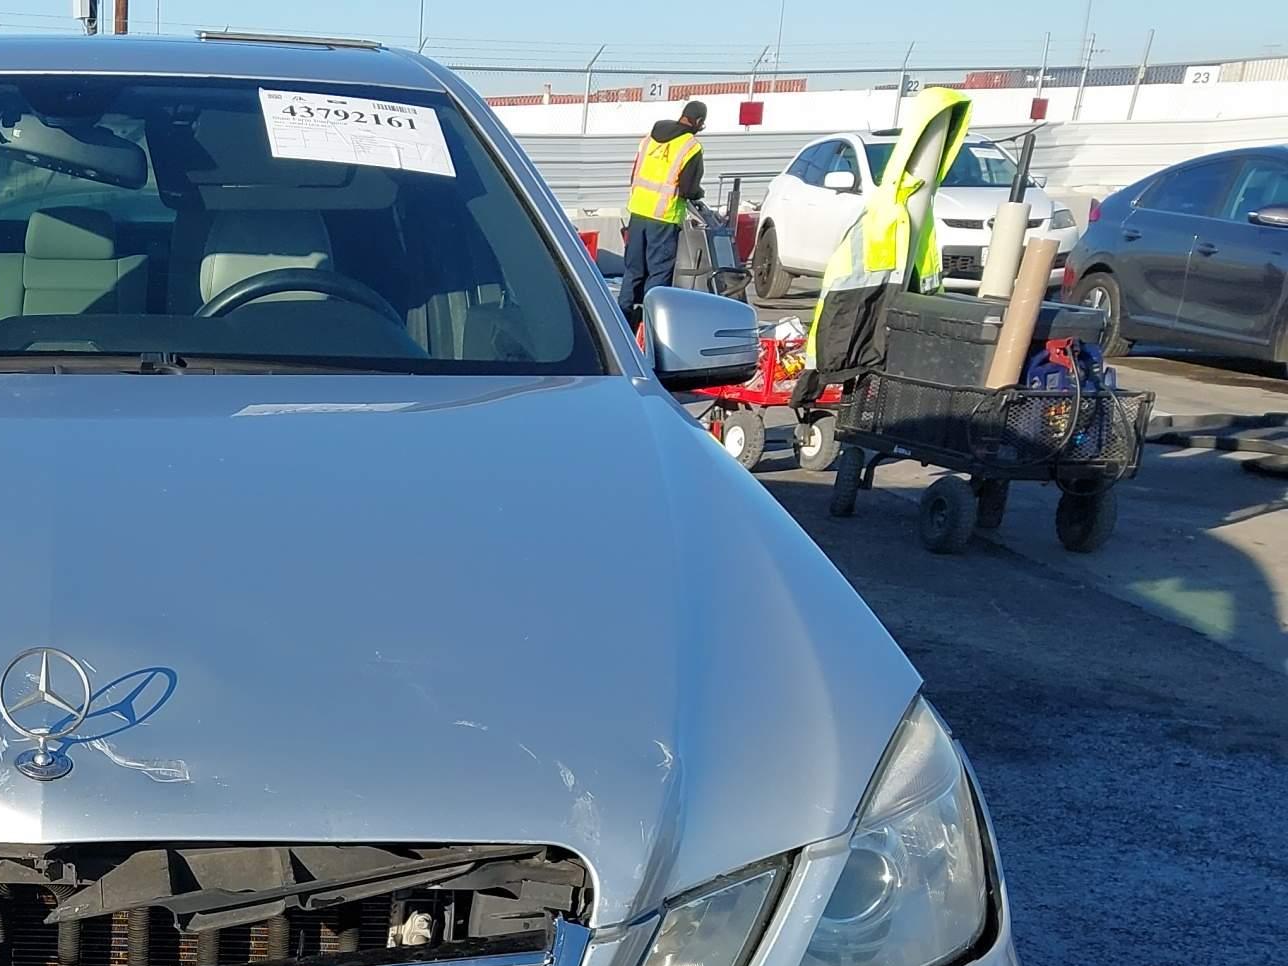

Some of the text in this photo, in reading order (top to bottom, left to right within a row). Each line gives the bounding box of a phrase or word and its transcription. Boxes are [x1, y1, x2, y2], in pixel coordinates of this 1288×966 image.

[1192, 72, 1210, 83] 23
[649, 83, 662, 96] 21
[907, 80, 919, 91] 22
[282, 105, 416, 129] 43792161
